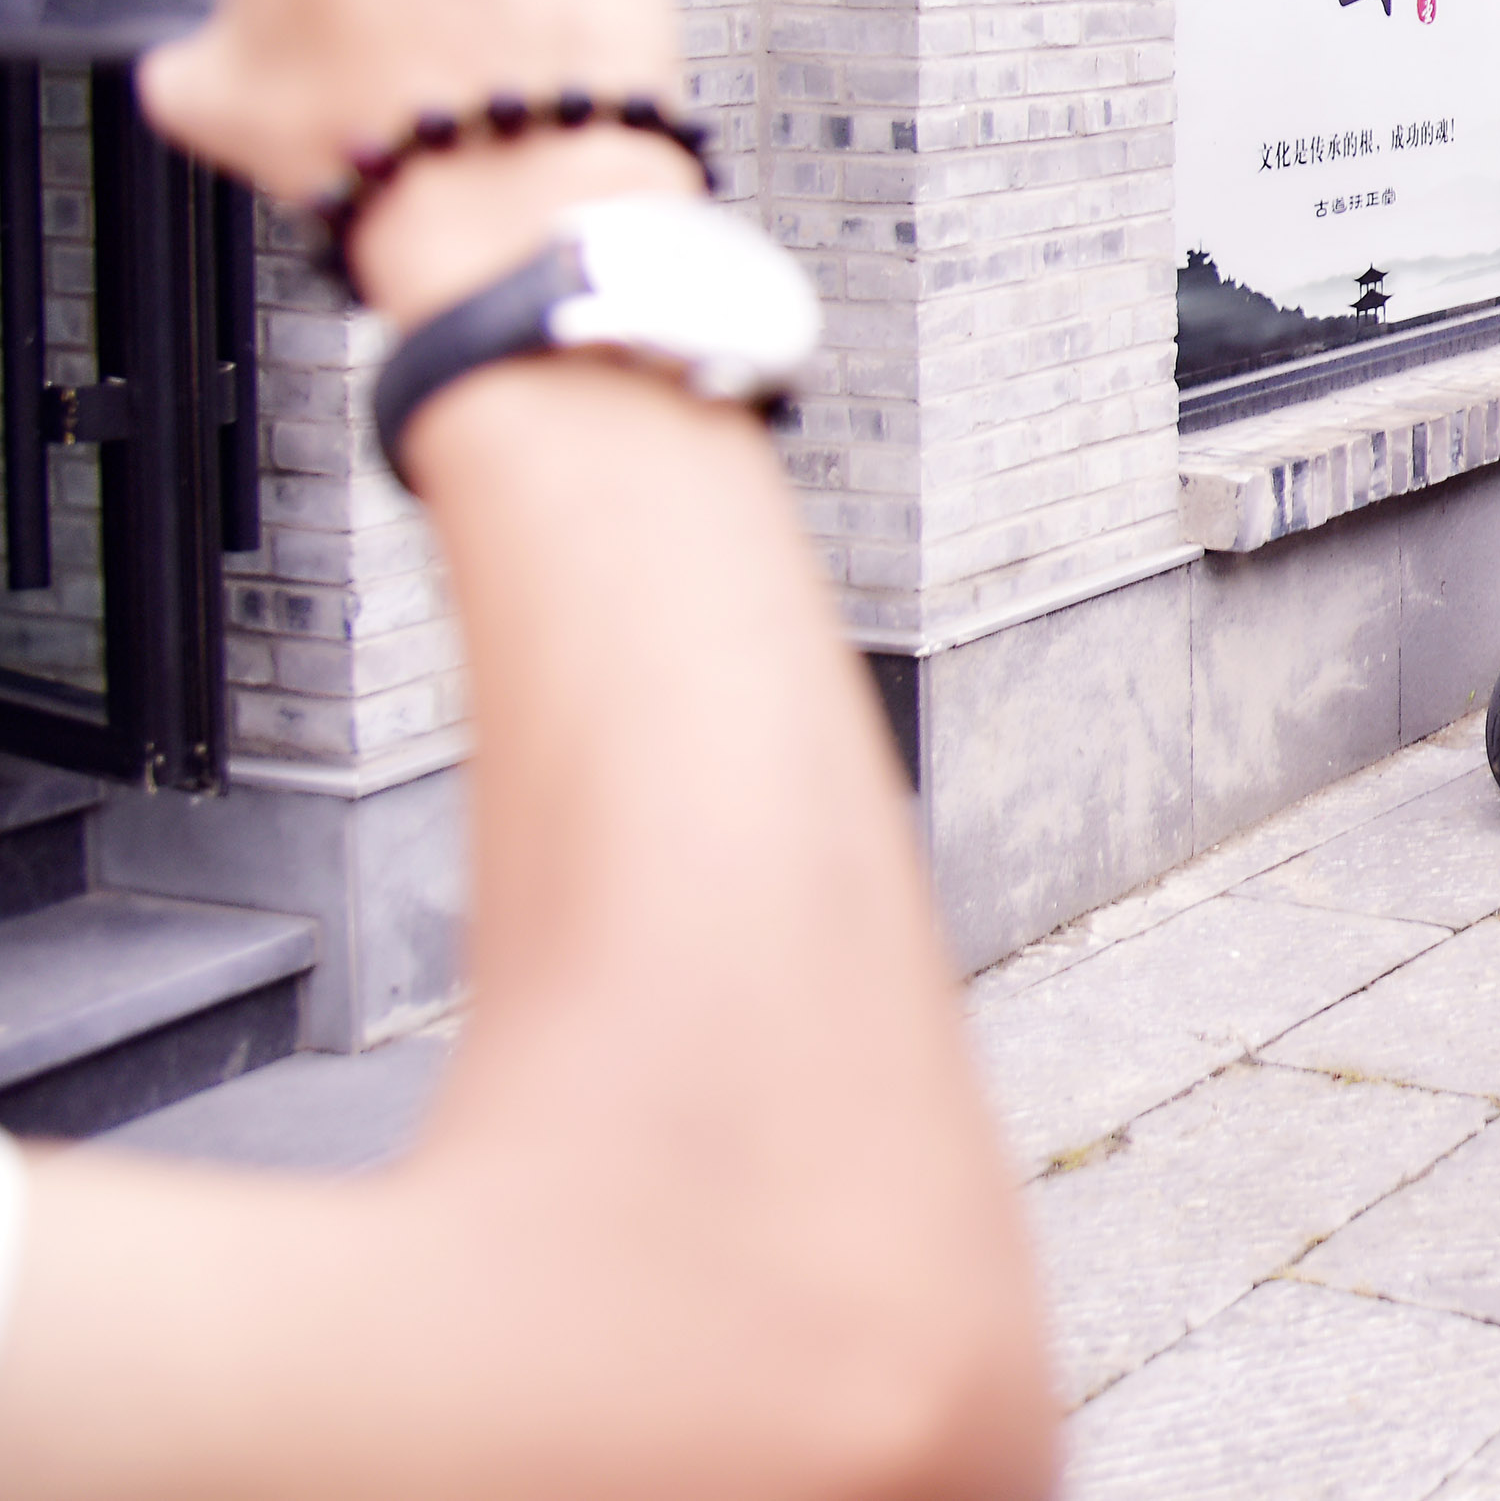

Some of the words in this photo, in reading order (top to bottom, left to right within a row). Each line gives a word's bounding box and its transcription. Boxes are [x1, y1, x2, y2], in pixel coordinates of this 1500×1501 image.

[1258, 118, 1455, 173] 文化是传承的根，成功的魂！
